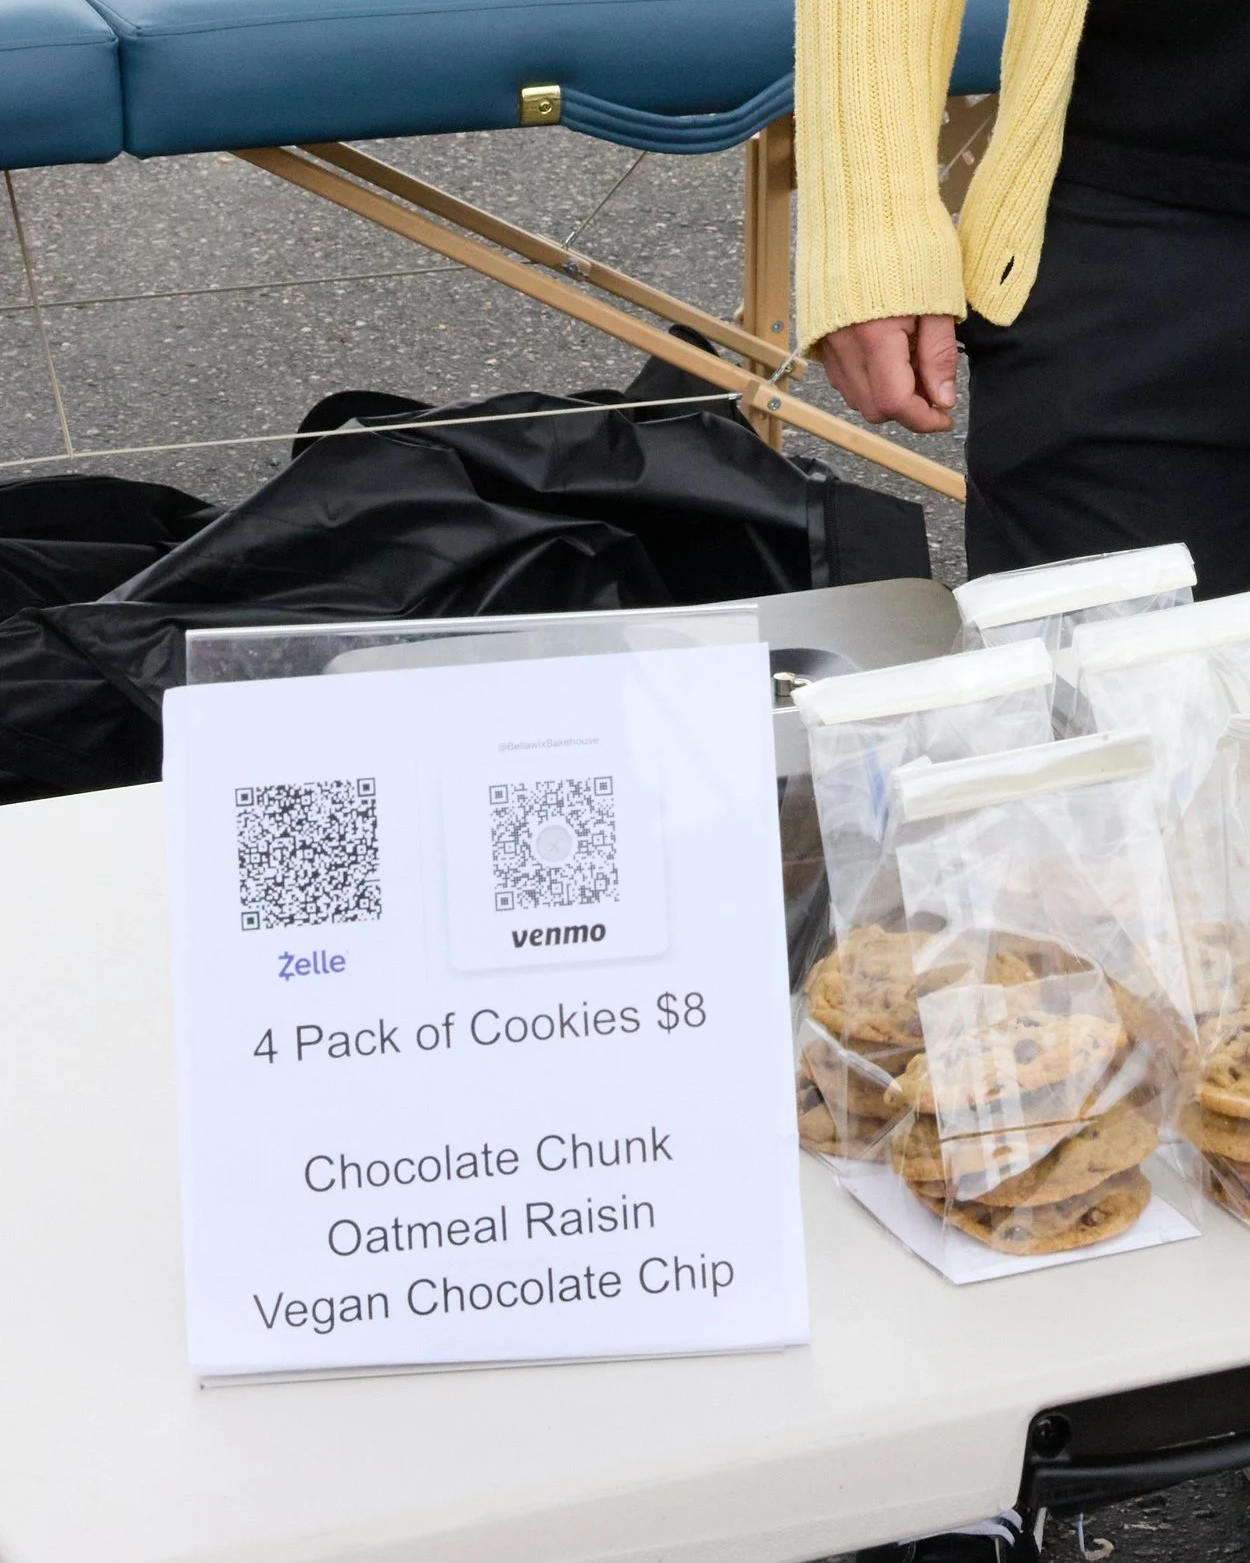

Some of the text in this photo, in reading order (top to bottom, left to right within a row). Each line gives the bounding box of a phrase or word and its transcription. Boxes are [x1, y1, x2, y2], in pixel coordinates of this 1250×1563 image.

[278, 950, 347, 982] Zelle
[511, 922, 607, 949] venmo
[253, 990, 707, 1065] 4 Pack of Cookies $8
[304, 1125, 674, 1193] Chocolate Chunk
[327, 1193, 655, 1257] Oatmeal Raisin
[252, 1253, 735, 1335] Vegan Chocolate Chip
